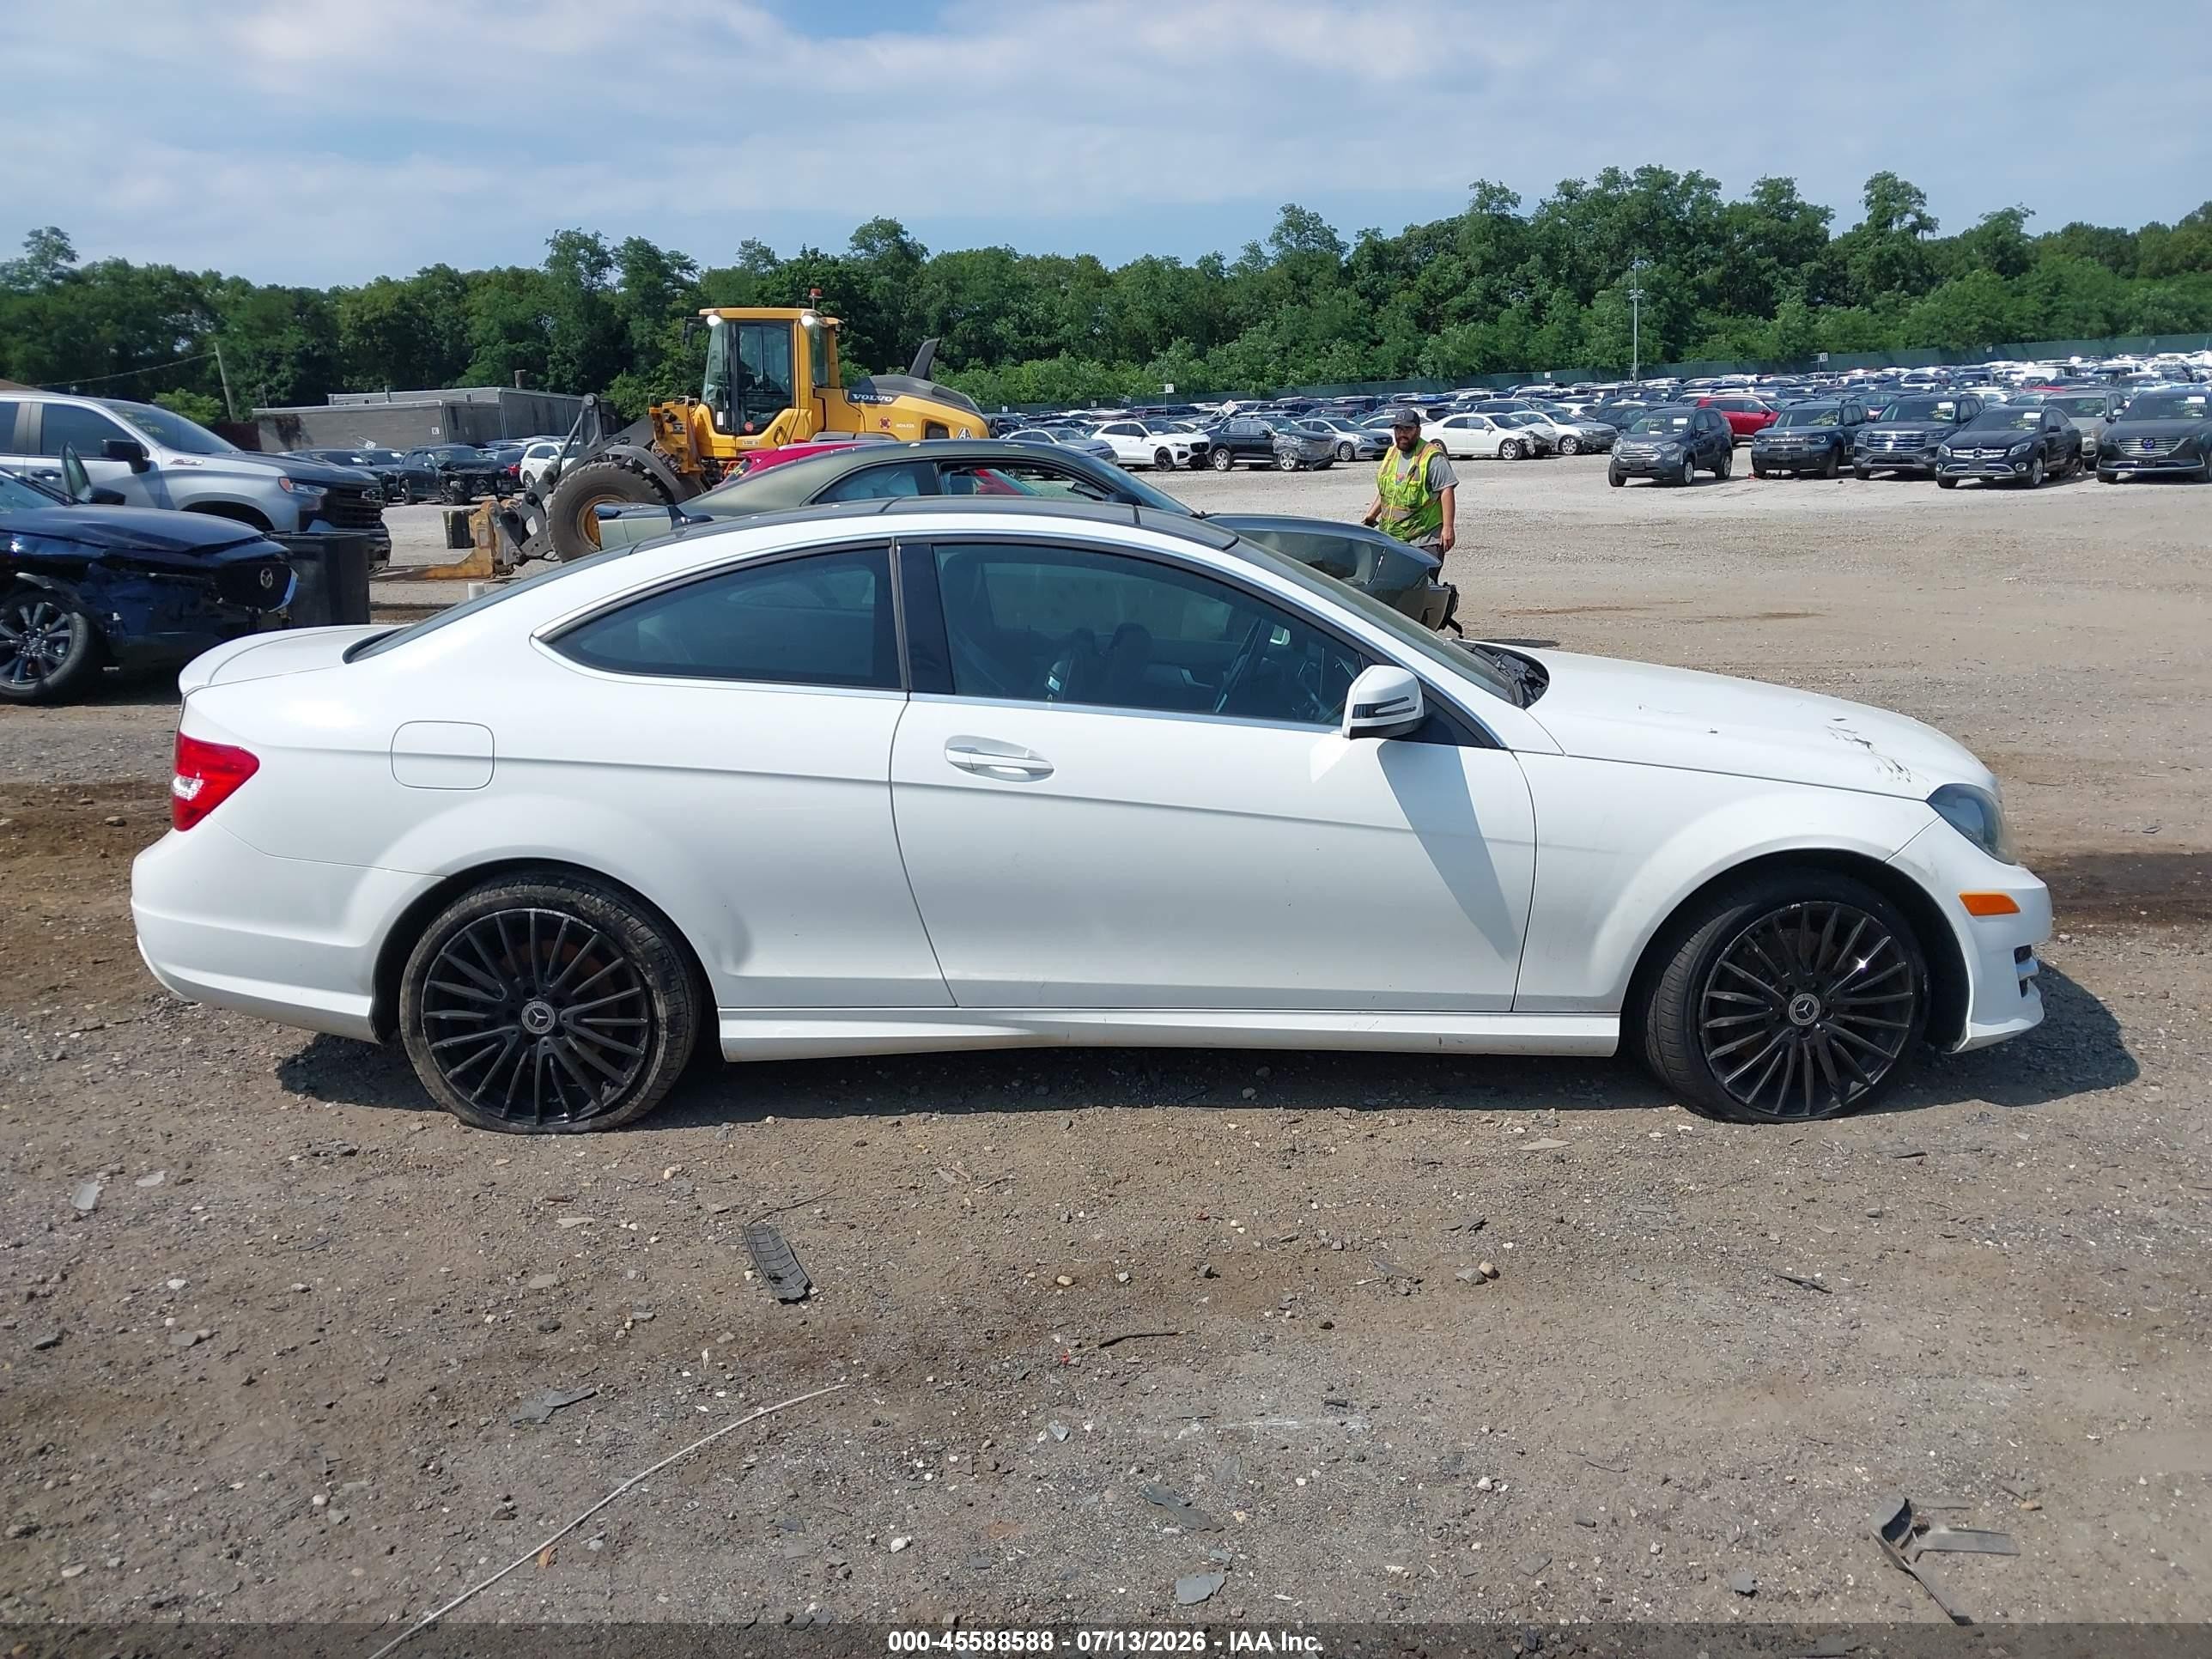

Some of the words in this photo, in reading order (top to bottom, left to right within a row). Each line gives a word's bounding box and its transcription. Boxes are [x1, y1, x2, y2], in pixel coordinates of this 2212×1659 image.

[1166, 384, 1174, 392] 40
[852, 393, 893, 402] VOLVO
[1224, 401, 1236, 412] 40
